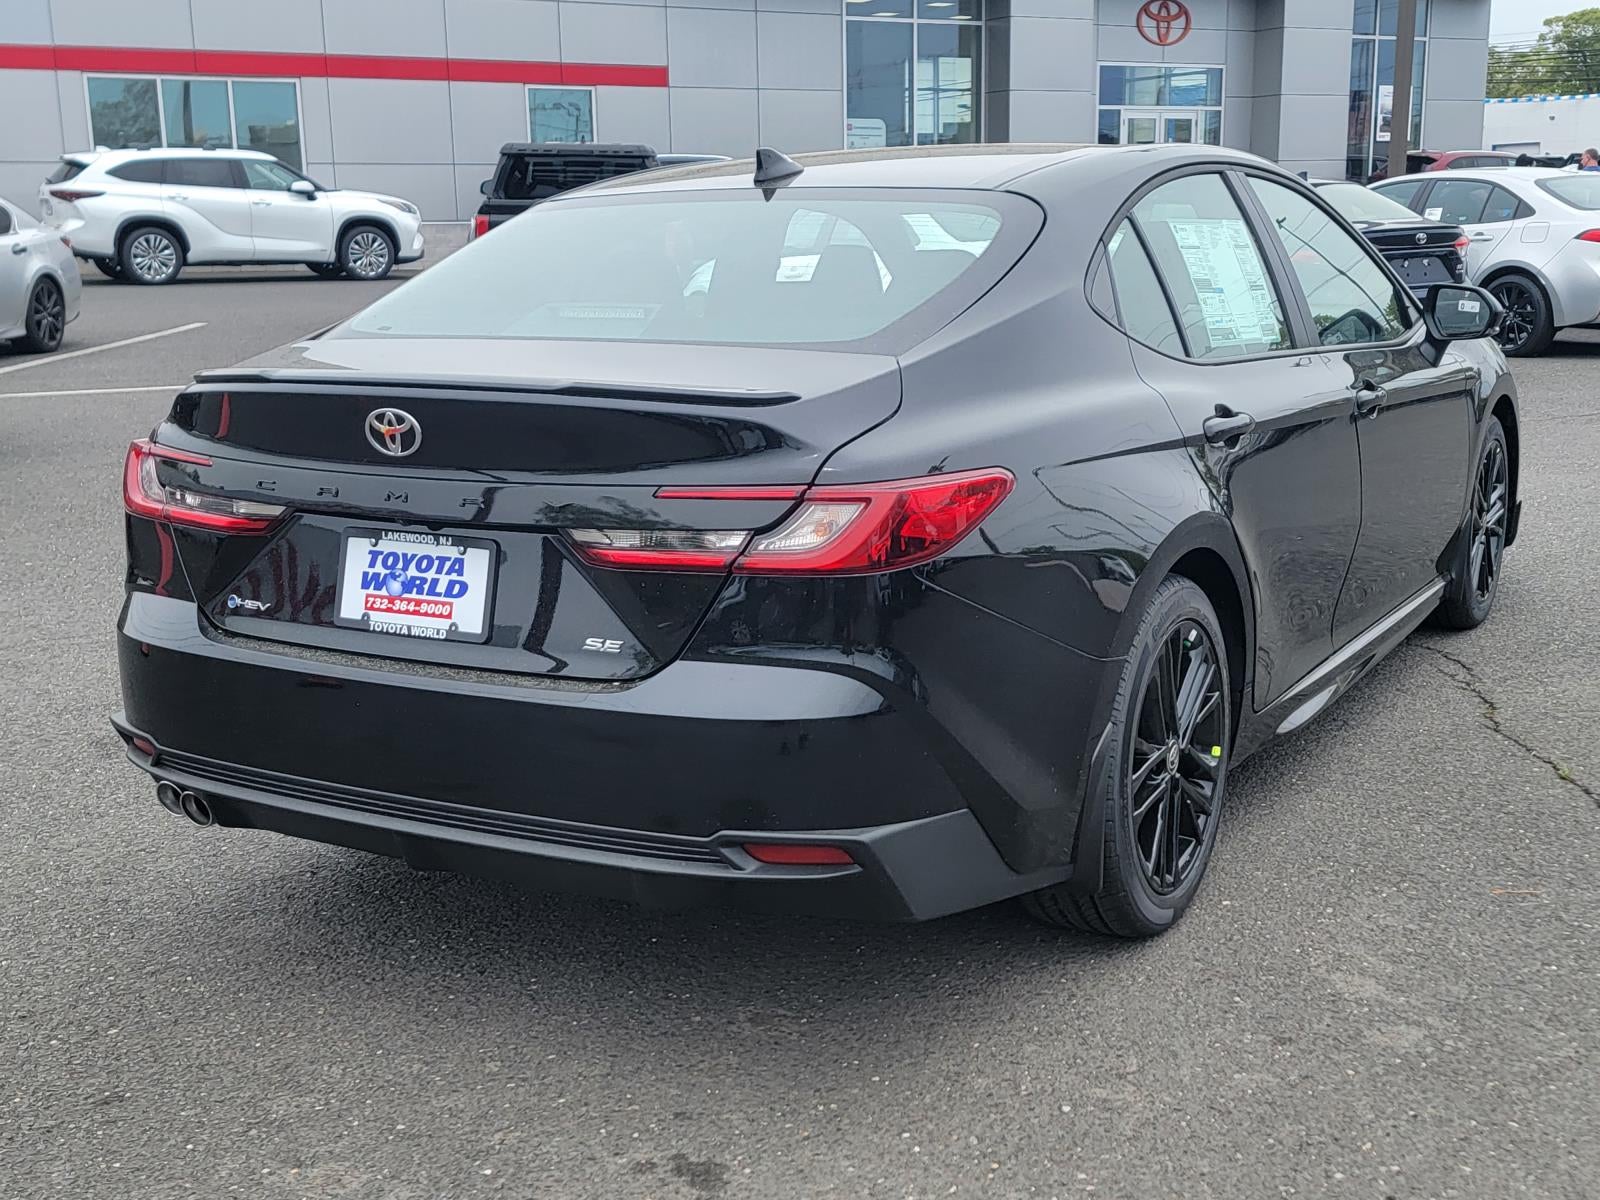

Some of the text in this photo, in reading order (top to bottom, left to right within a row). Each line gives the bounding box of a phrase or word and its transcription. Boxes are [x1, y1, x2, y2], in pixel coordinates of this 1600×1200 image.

[381, 531, 453, 546] LAKEWOOD, NJ
[367, 549, 465, 577] TOYOTA
[360, 570, 469, 599] WORLD
[366, 597, 451, 616] 732-364-9000
[369, 621, 447, 639] TOYOTA WORLD
[581, 637, 625, 653] SE
